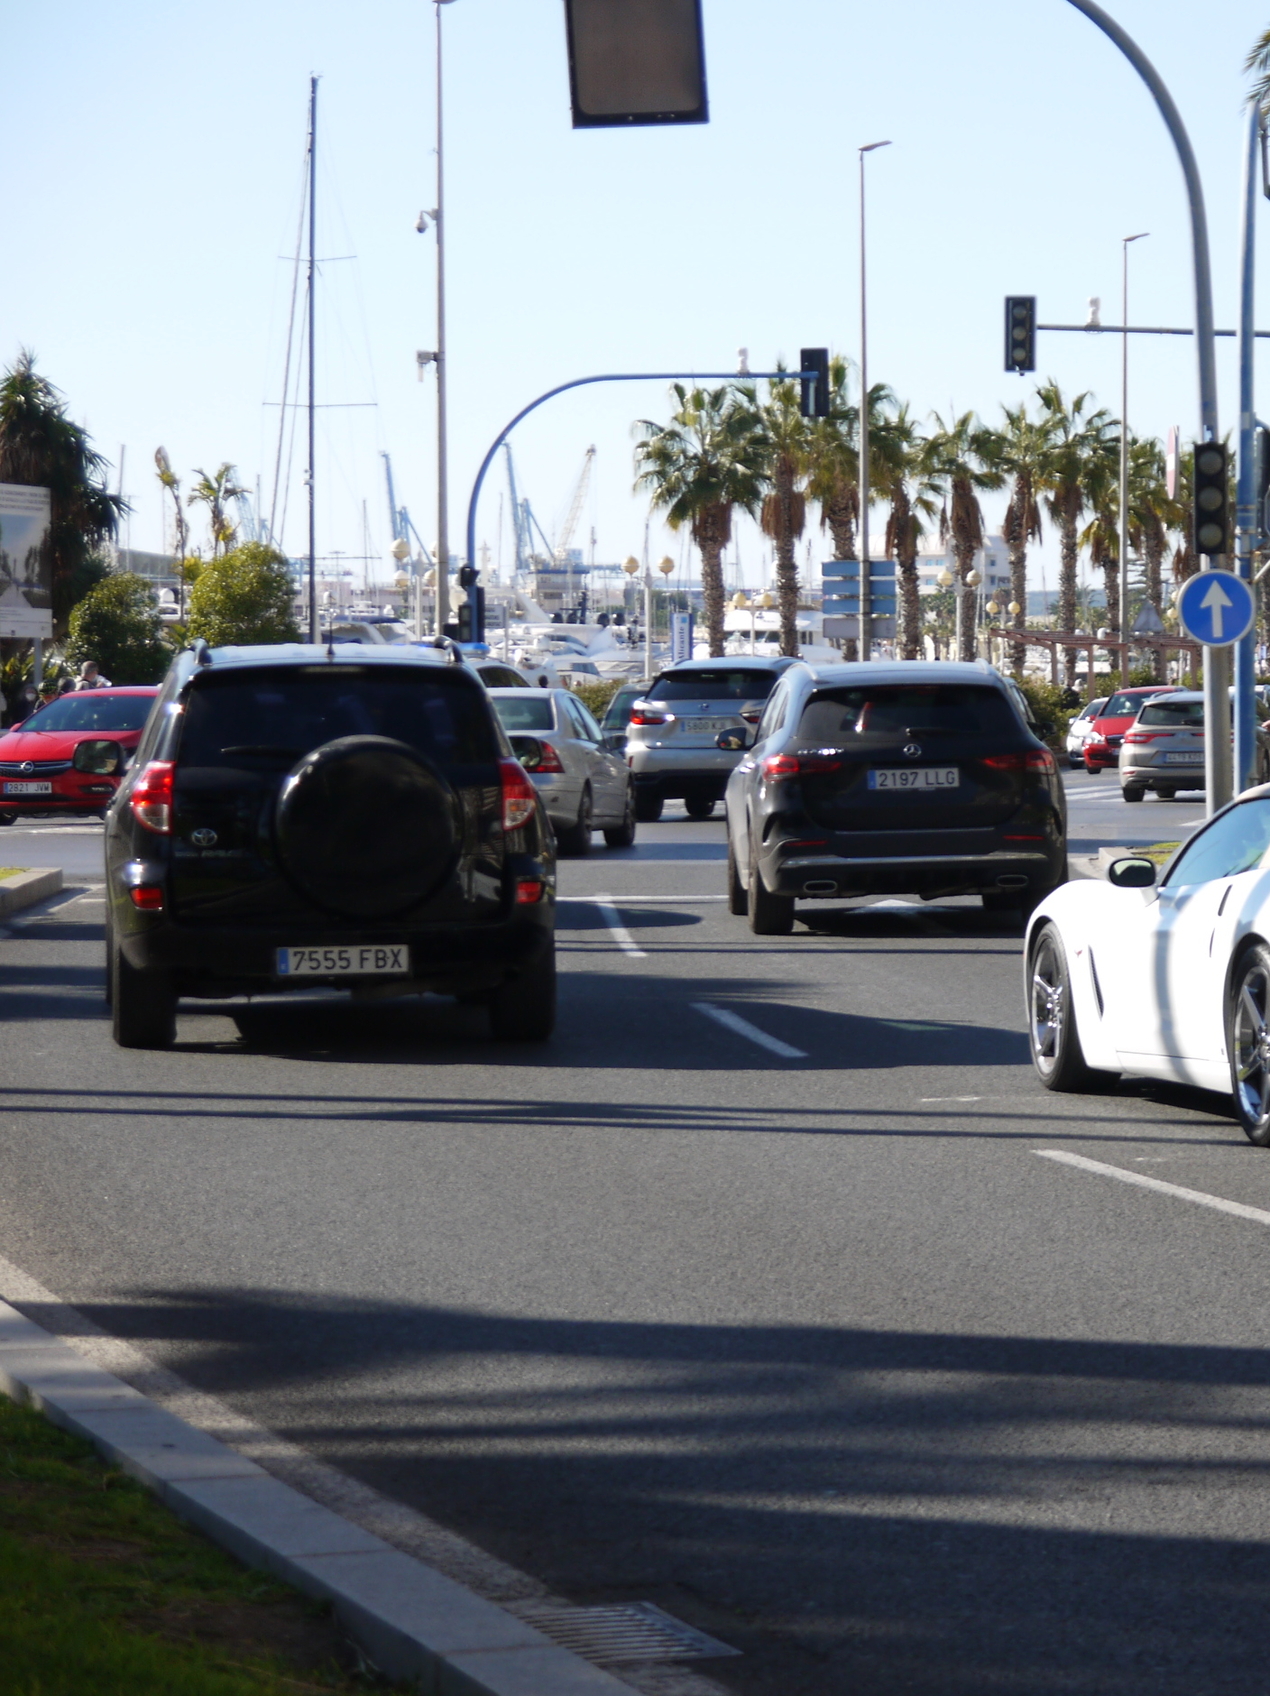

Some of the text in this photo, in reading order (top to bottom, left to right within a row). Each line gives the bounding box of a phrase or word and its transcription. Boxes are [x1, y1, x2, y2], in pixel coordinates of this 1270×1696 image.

[878, 770, 955, 787] 2197 LLG
[9, 783, 29, 792] 2821
[293, 948, 403, 971] 7555 FBX
